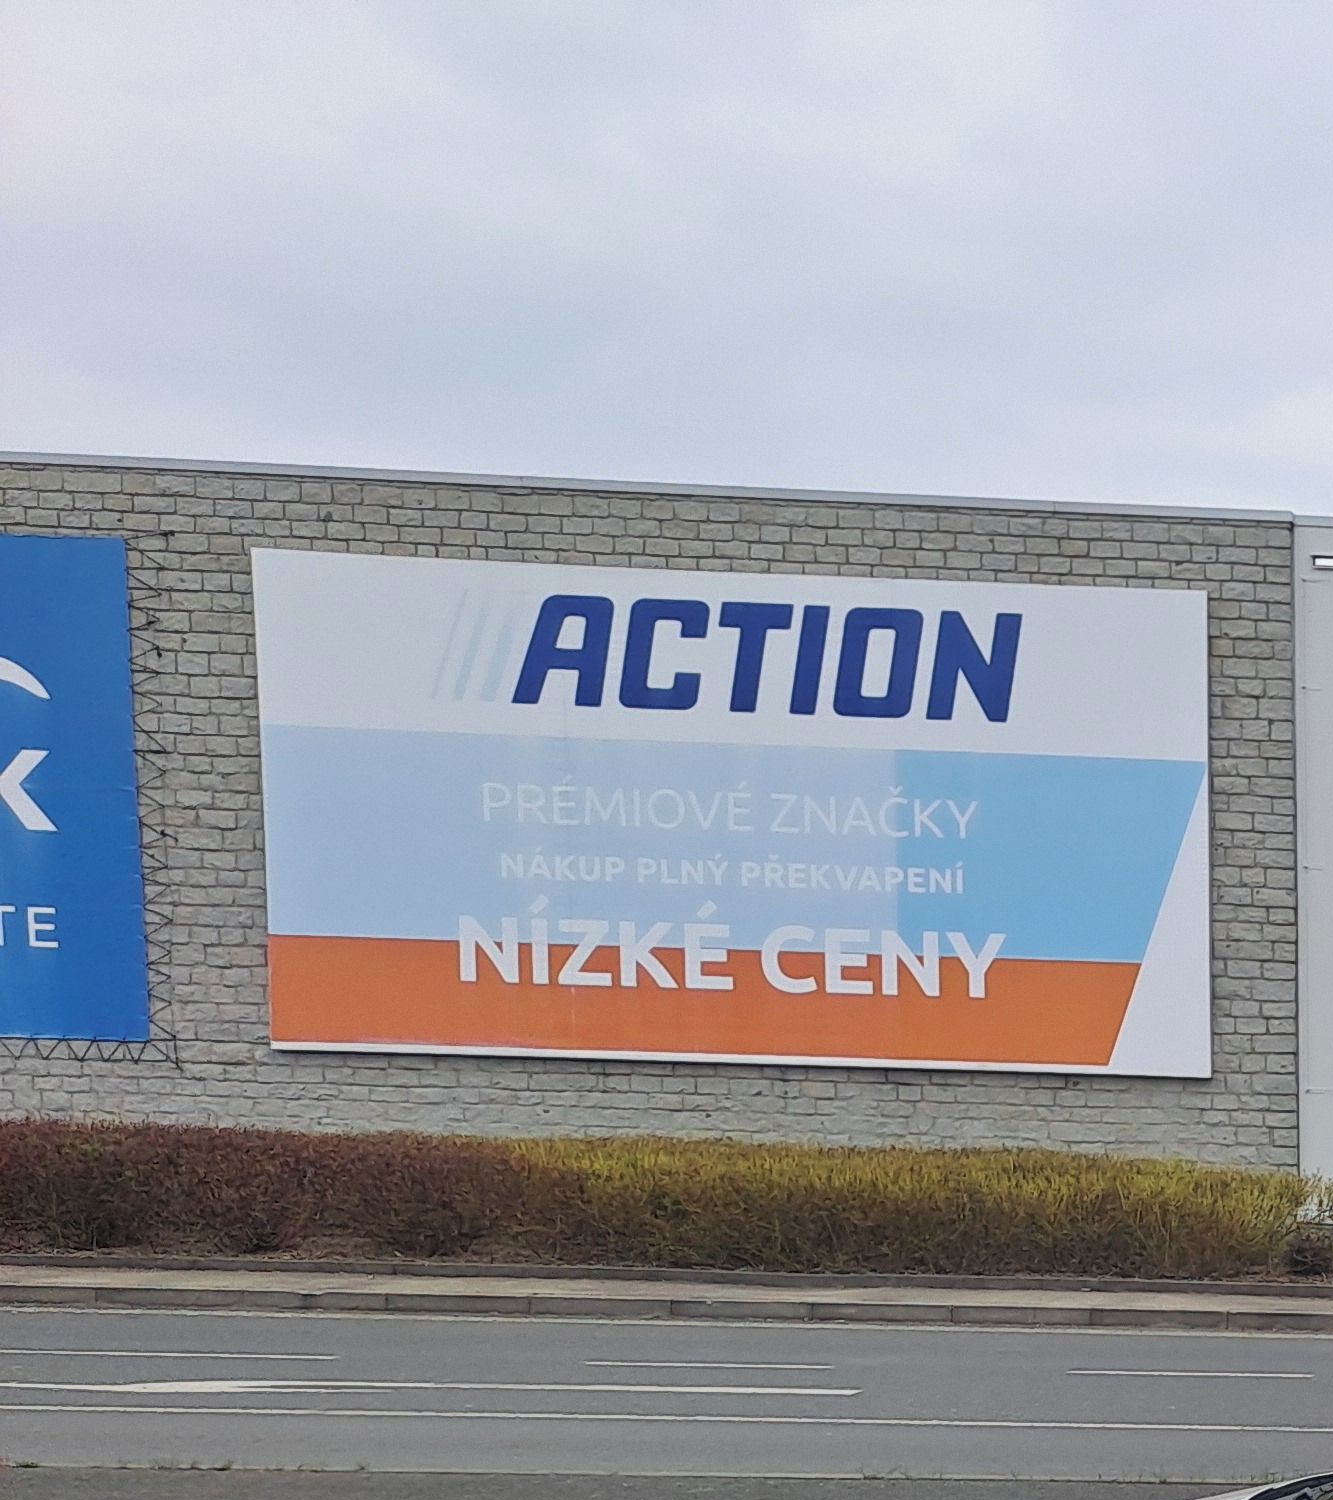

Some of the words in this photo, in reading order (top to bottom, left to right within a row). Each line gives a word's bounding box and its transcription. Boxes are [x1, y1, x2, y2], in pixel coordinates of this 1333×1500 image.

[511, 594, 1024, 723] ACTION
[481, 775, 754, 833] PRÉMIOVÉ
[769, 785, 979, 840] ZNAČKY
[500, 846, 625, 883] NÁKUP
[636, 852, 729, 886] PLNÝ
[740, 855, 965, 895] PŘEKVAPENÍ
[458, 894, 735, 991] NÍZKÉ
[760, 924, 1007, 999] CENY
